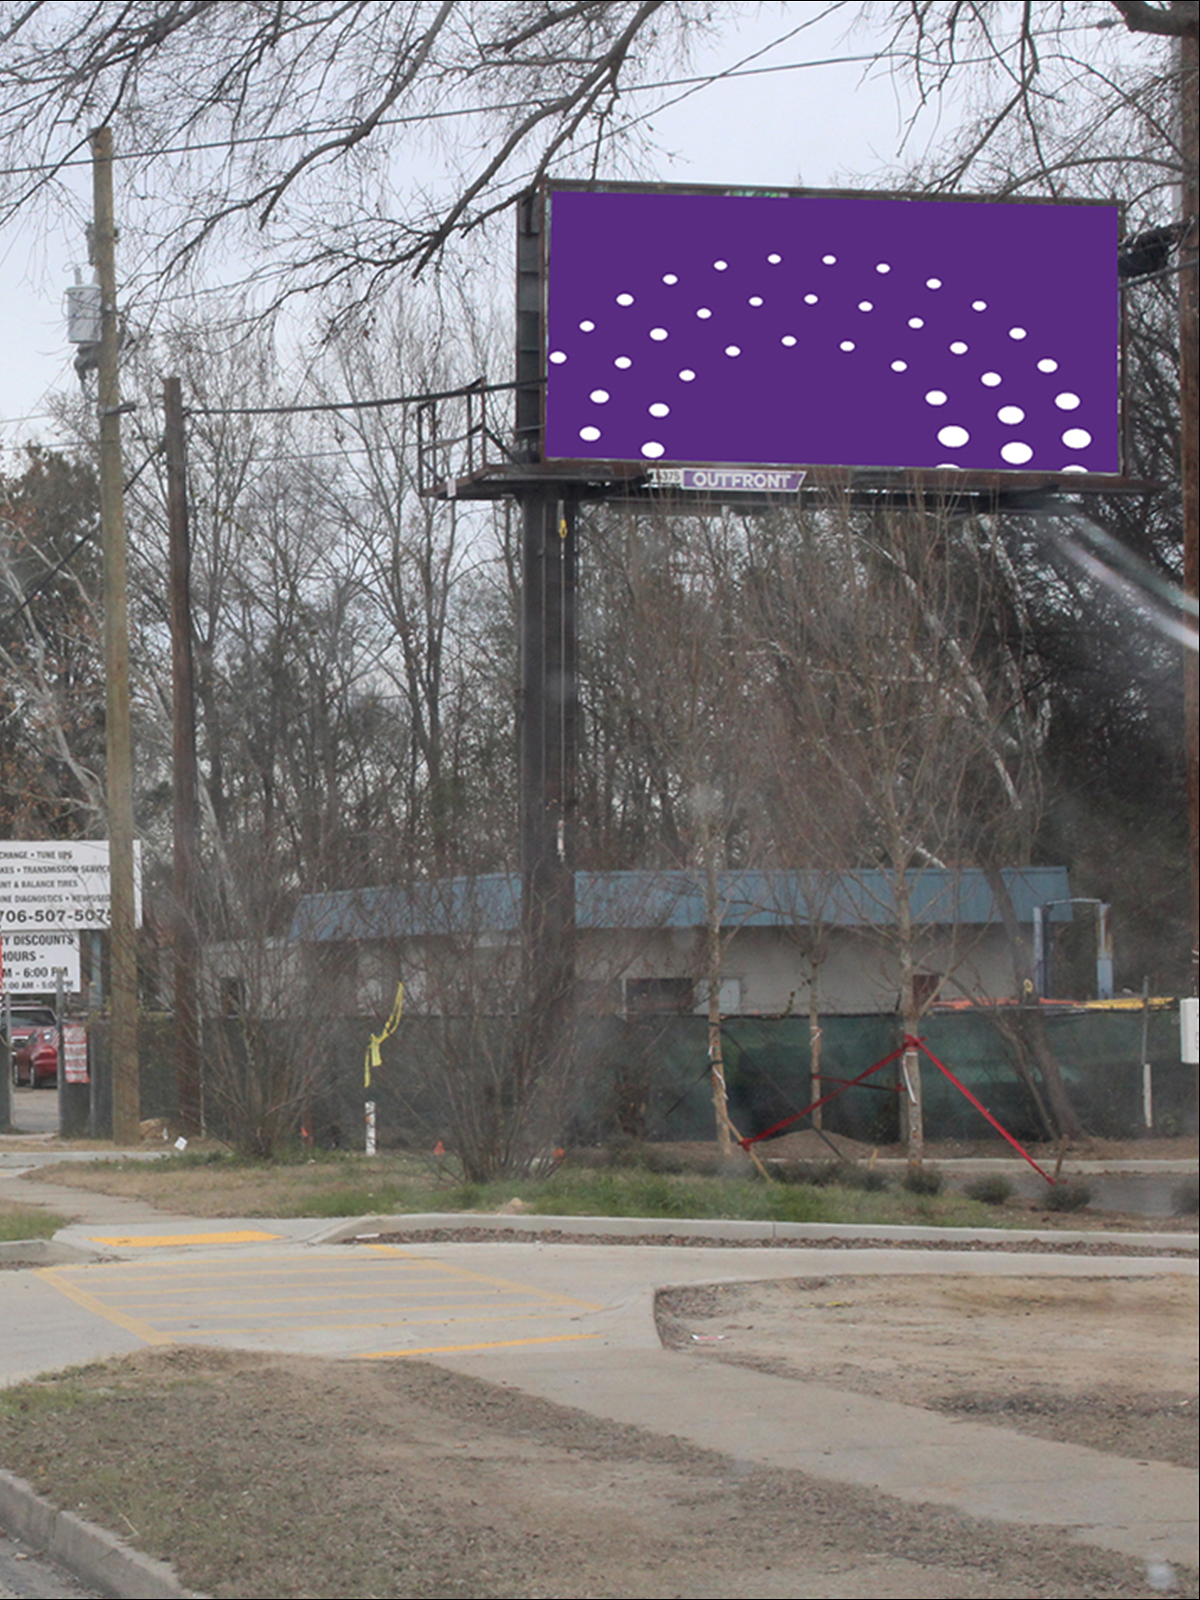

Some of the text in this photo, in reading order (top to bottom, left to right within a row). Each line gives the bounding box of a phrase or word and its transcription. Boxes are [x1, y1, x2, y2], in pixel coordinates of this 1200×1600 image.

[693, 472, 791, 488] OUTFRONT
[36, 850, 56, 859] TUNE
[23, 865, 110, 874] TRANSMISSION SERVIC
[21, 880, 55, 888] BALANCE
[57, 880, 78, 888] TIRES
[14, 894, 63, 902] DIAGNOSTICS
[13, 934, 74, 945] DISCOUNTS
[2, 951, 36, 961] HOURS
[23, 967, 48, 978] 6:00
[22, 981, 34, 989] AM
